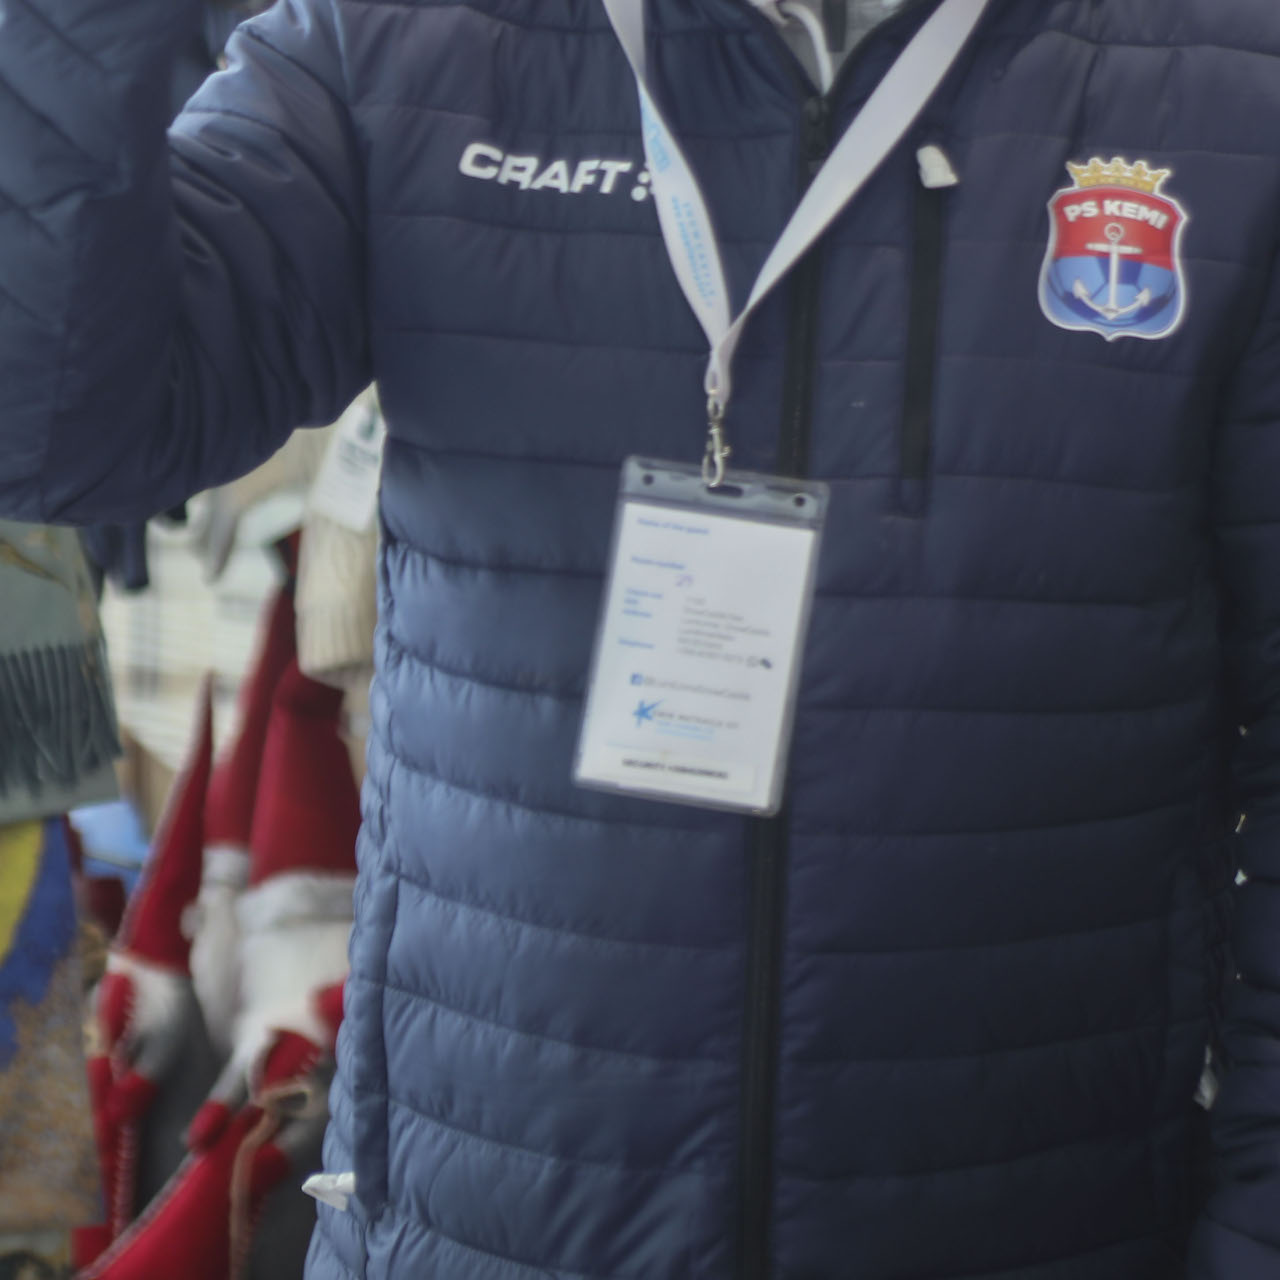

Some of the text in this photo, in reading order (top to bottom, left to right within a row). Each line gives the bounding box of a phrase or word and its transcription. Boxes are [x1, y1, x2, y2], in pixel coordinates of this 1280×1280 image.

[459, 142, 633, 194] CRAFT
[1063, 199, 1169, 230] PS KEMI
